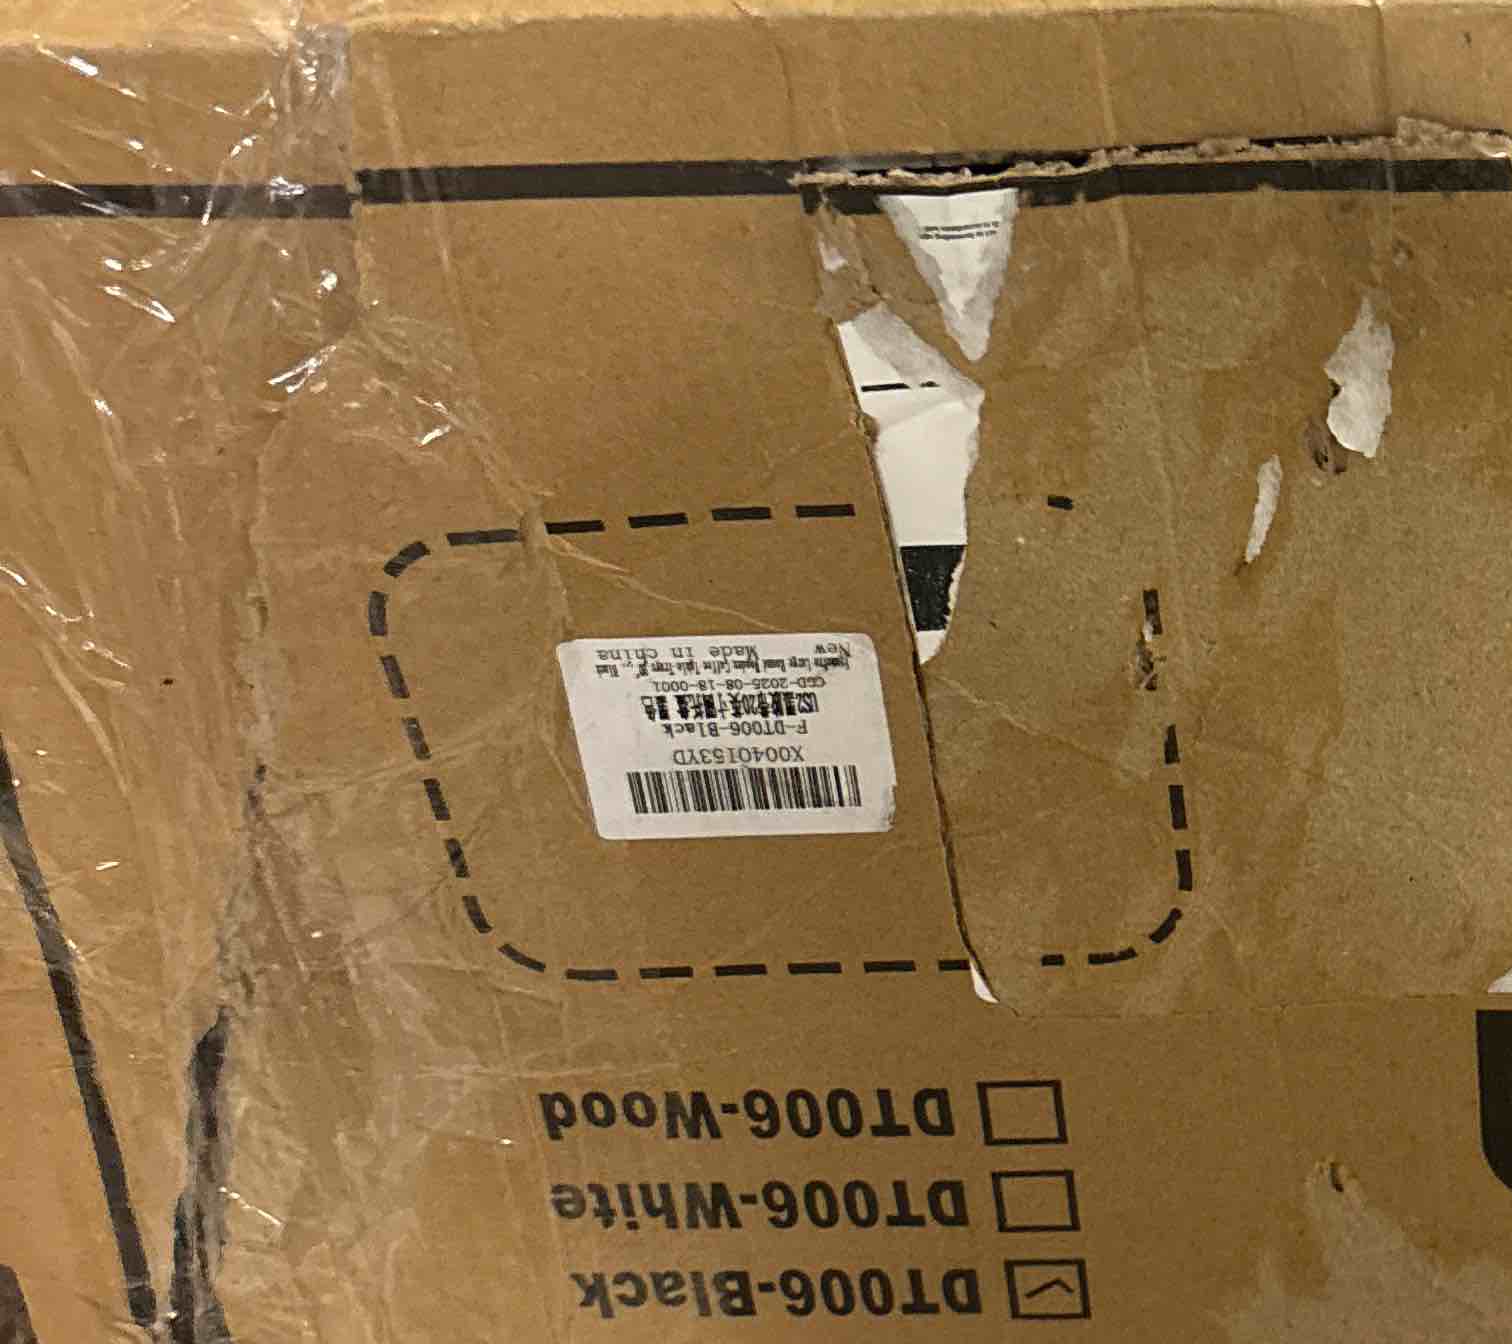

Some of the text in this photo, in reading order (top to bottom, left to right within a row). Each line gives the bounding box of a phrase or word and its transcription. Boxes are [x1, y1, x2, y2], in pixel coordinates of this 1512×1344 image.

[709, 643, 758, 659] Made
[815, 641, 851, 658] New
[663, 718, 809, 739] F-DT006-Black
[538, 1087, 956, 1141] DT006-Wood
[549, 1179, 969, 1232] DT006-White
[568, 1266, 983, 1319] DT006-Black
